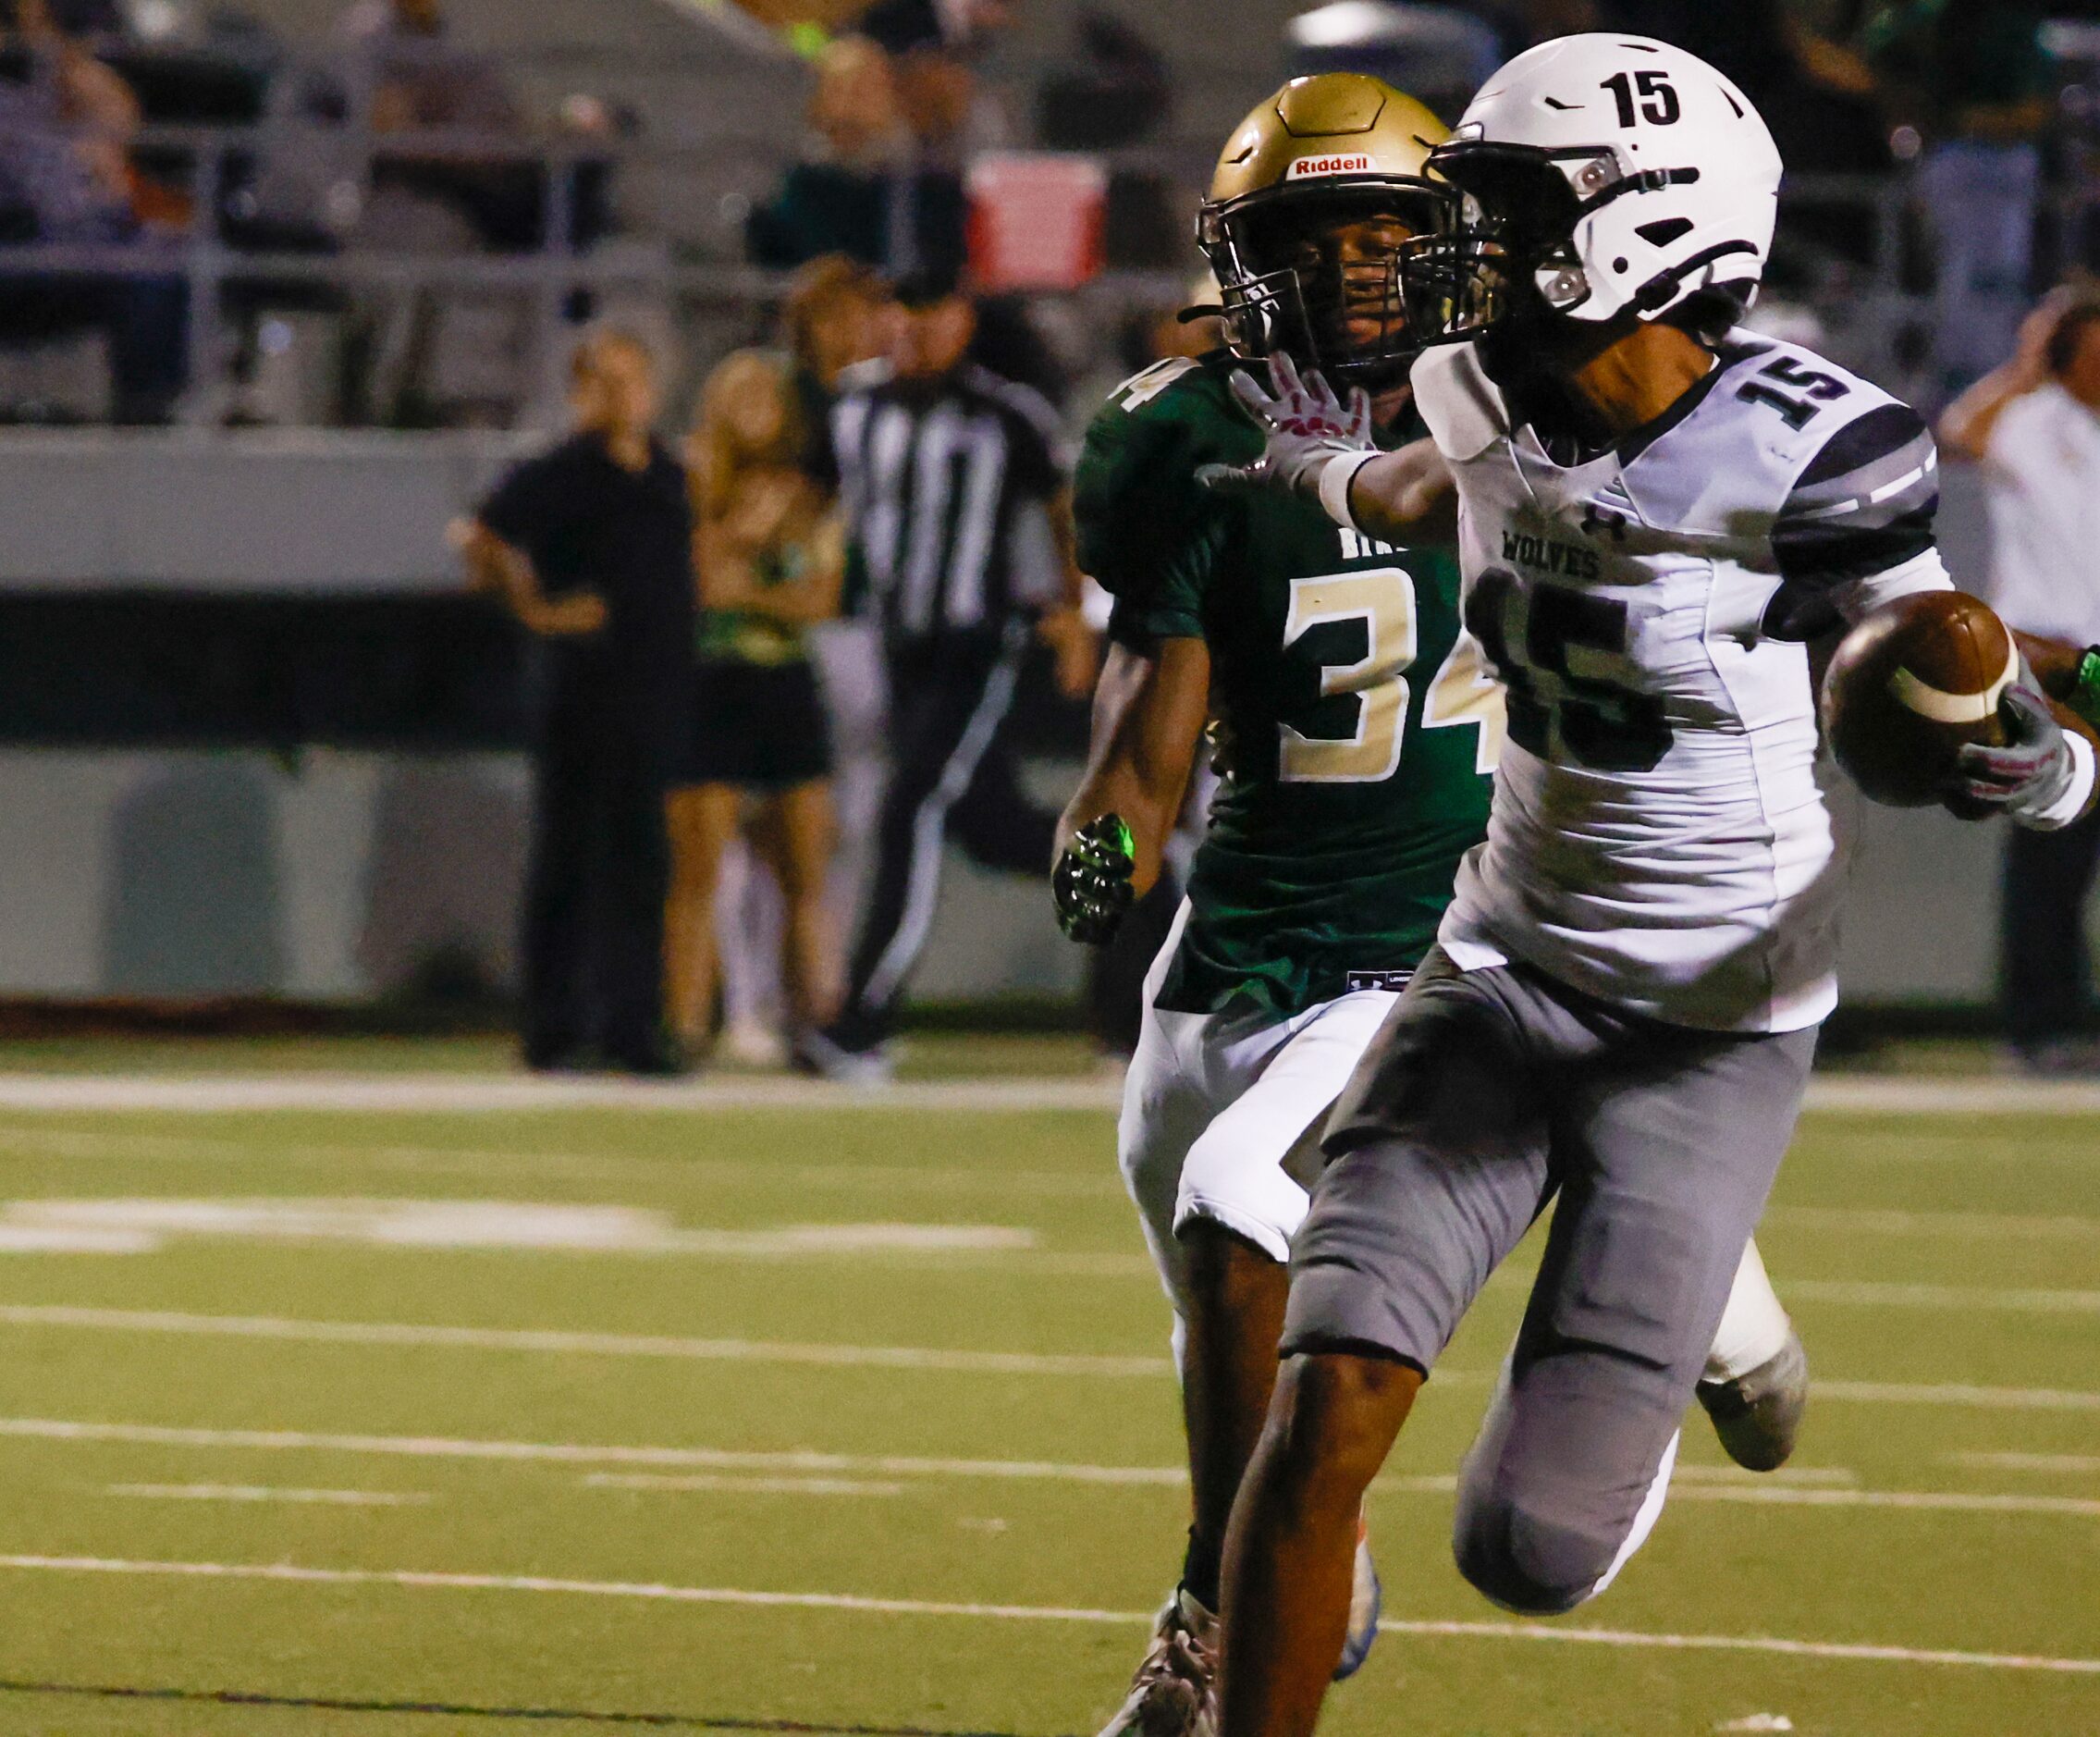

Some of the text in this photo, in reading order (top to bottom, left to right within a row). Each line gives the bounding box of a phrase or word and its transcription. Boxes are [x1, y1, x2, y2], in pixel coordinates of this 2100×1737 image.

[1600, 70, 1680, 128] 15
[1296, 157, 1368, 174] Riddell
[1735, 355, 1850, 432] 15
[1503, 530, 1599, 580] WOLVES
[1280, 567, 1507, 782] 34
[1466, 567, 1675, 773] 15
